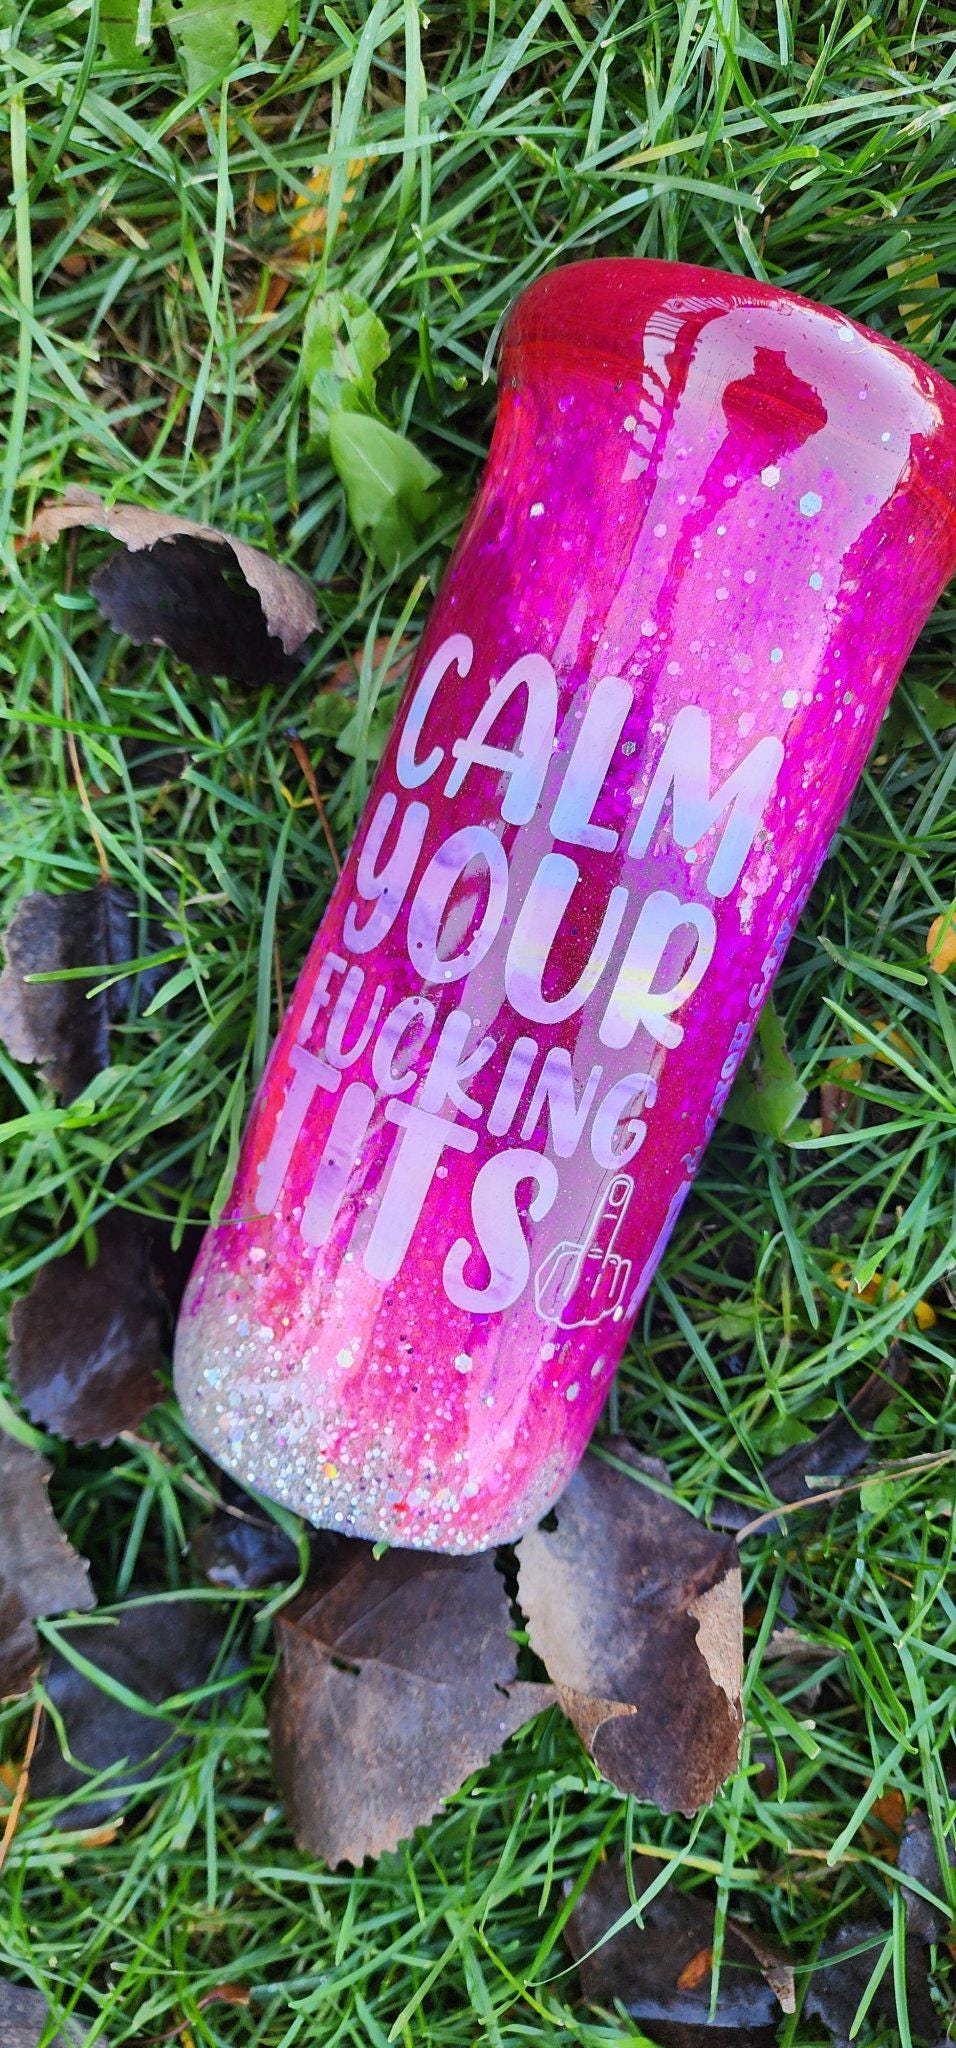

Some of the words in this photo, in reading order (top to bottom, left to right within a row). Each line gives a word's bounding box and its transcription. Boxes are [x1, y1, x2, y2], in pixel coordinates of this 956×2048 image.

[395, 633, 783, 898] CALM
[343, 793, 717, 1050] YOUR
[255, 1043, 559, 1314] TITS
[296, 952, 658, 1170] FUCKING
